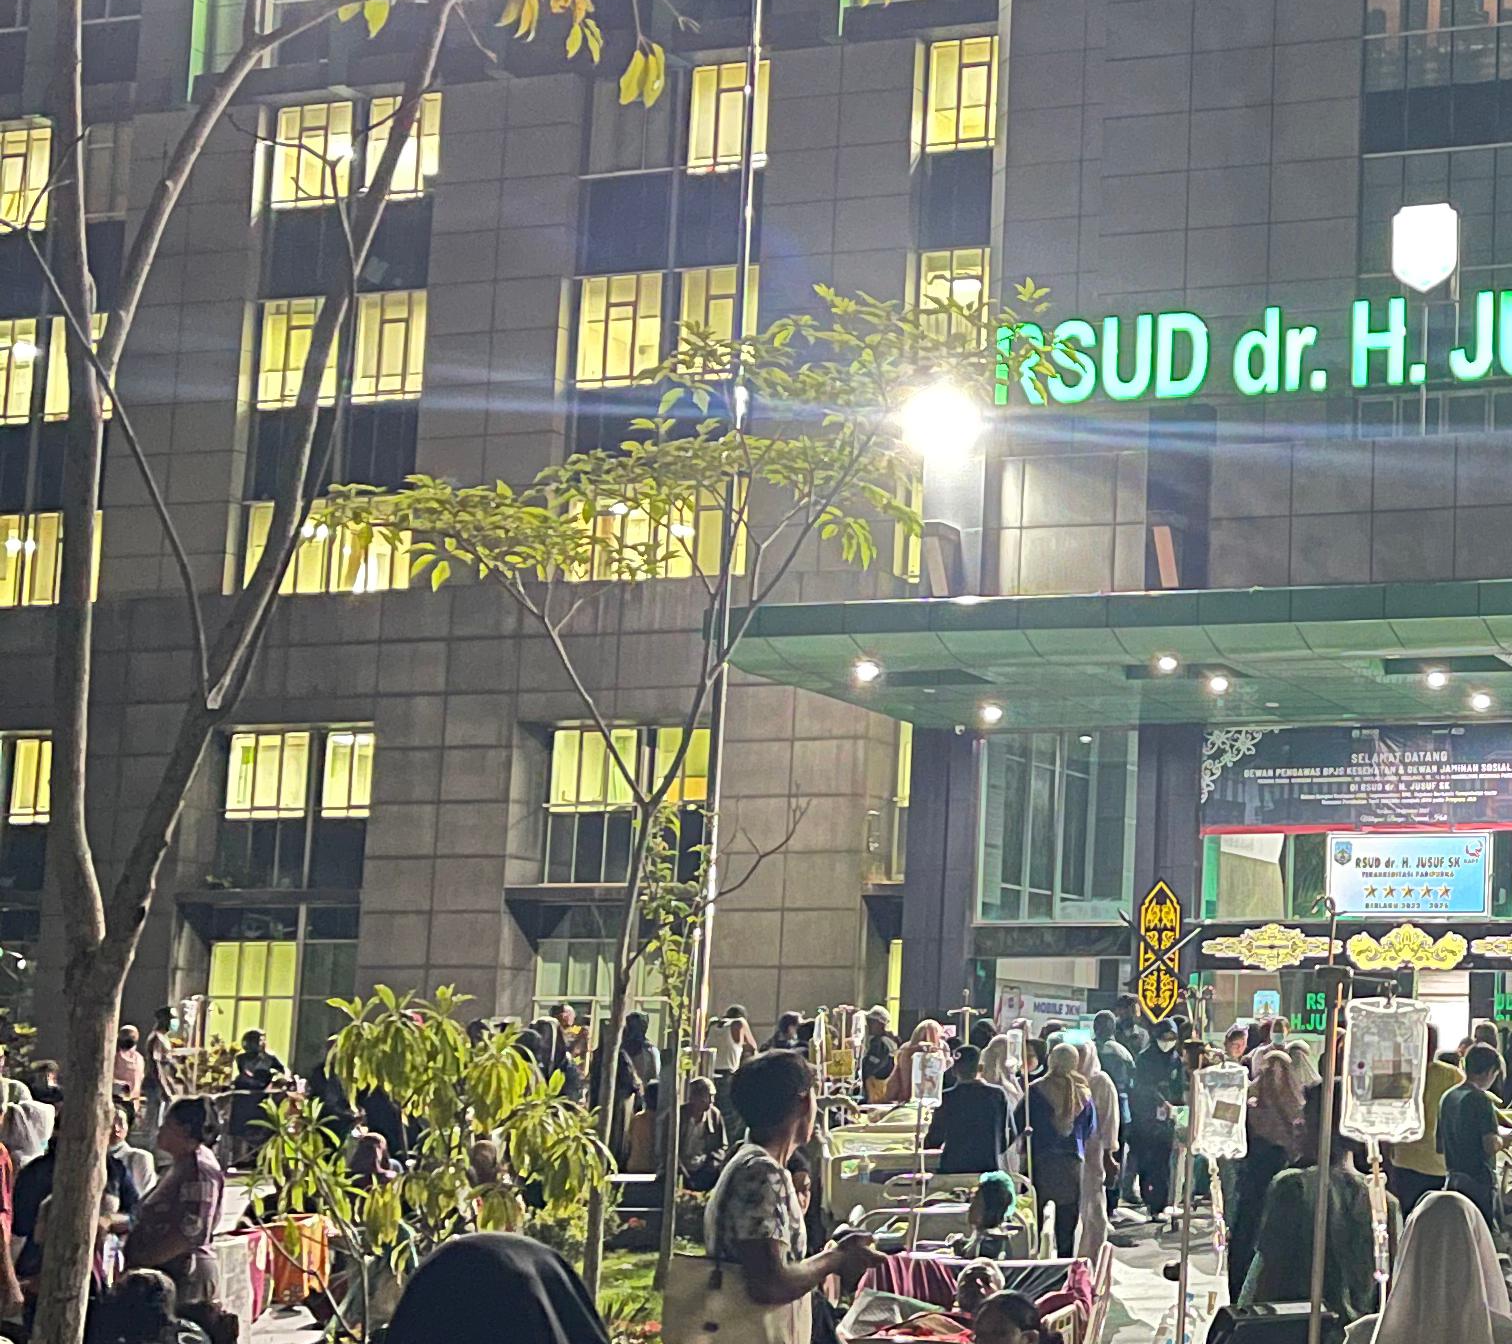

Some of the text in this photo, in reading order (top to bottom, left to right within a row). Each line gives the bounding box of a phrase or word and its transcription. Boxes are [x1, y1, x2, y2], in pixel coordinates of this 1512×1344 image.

[995, 311, 1209, 406] RSUD
[1233, 306, 1327, 396] dr.
[1352, 297, 1426, 389] H.
[1351, 751, 1448, 764] SELAMAT DATANG
[1481, 762, 1512, 772] SOSIAL
[1409, 781, 1436, 791] JUSUF
[1355, 856, 1461, 869] RSUD dr. H. JUSUF SK
